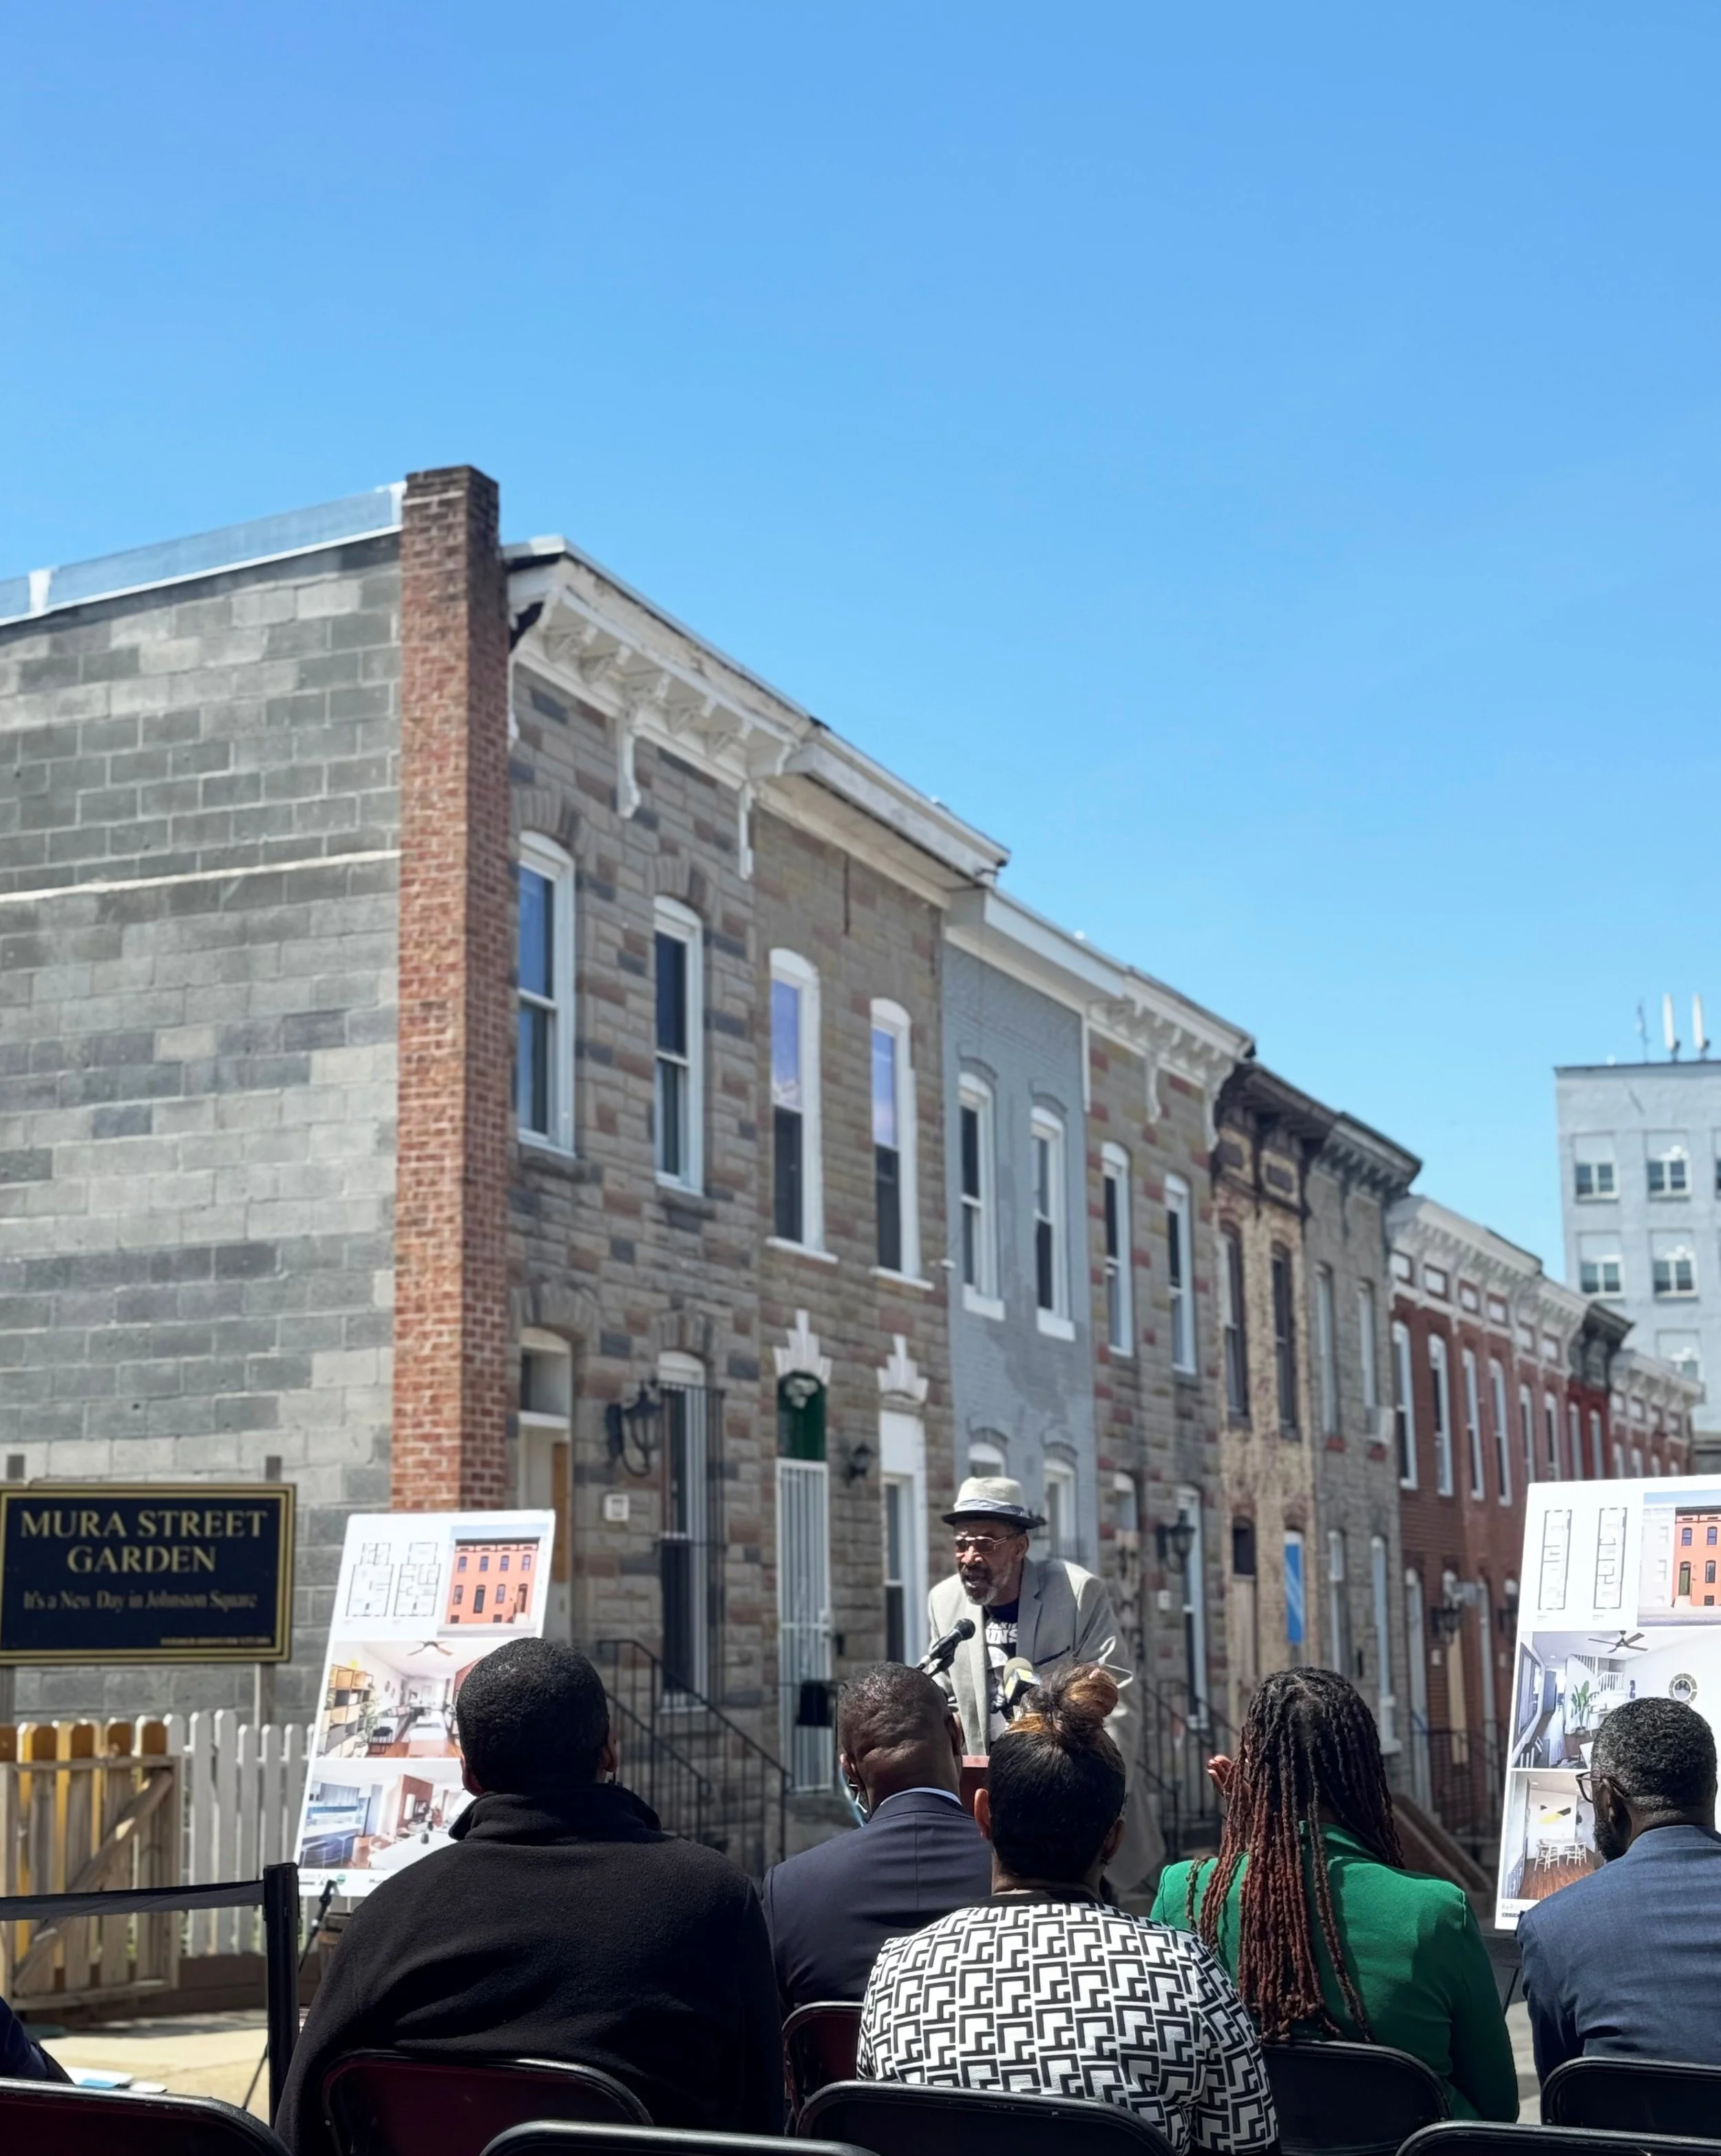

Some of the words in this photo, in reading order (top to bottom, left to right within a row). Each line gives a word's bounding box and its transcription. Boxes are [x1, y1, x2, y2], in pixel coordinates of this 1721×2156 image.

[21, 1511, 127, 1538] MURA
[138, 1510, 268, 1538] STREET
[67, 1546, 216, 1573] GARDEN
[96, 1589, 124, 1613] Day
